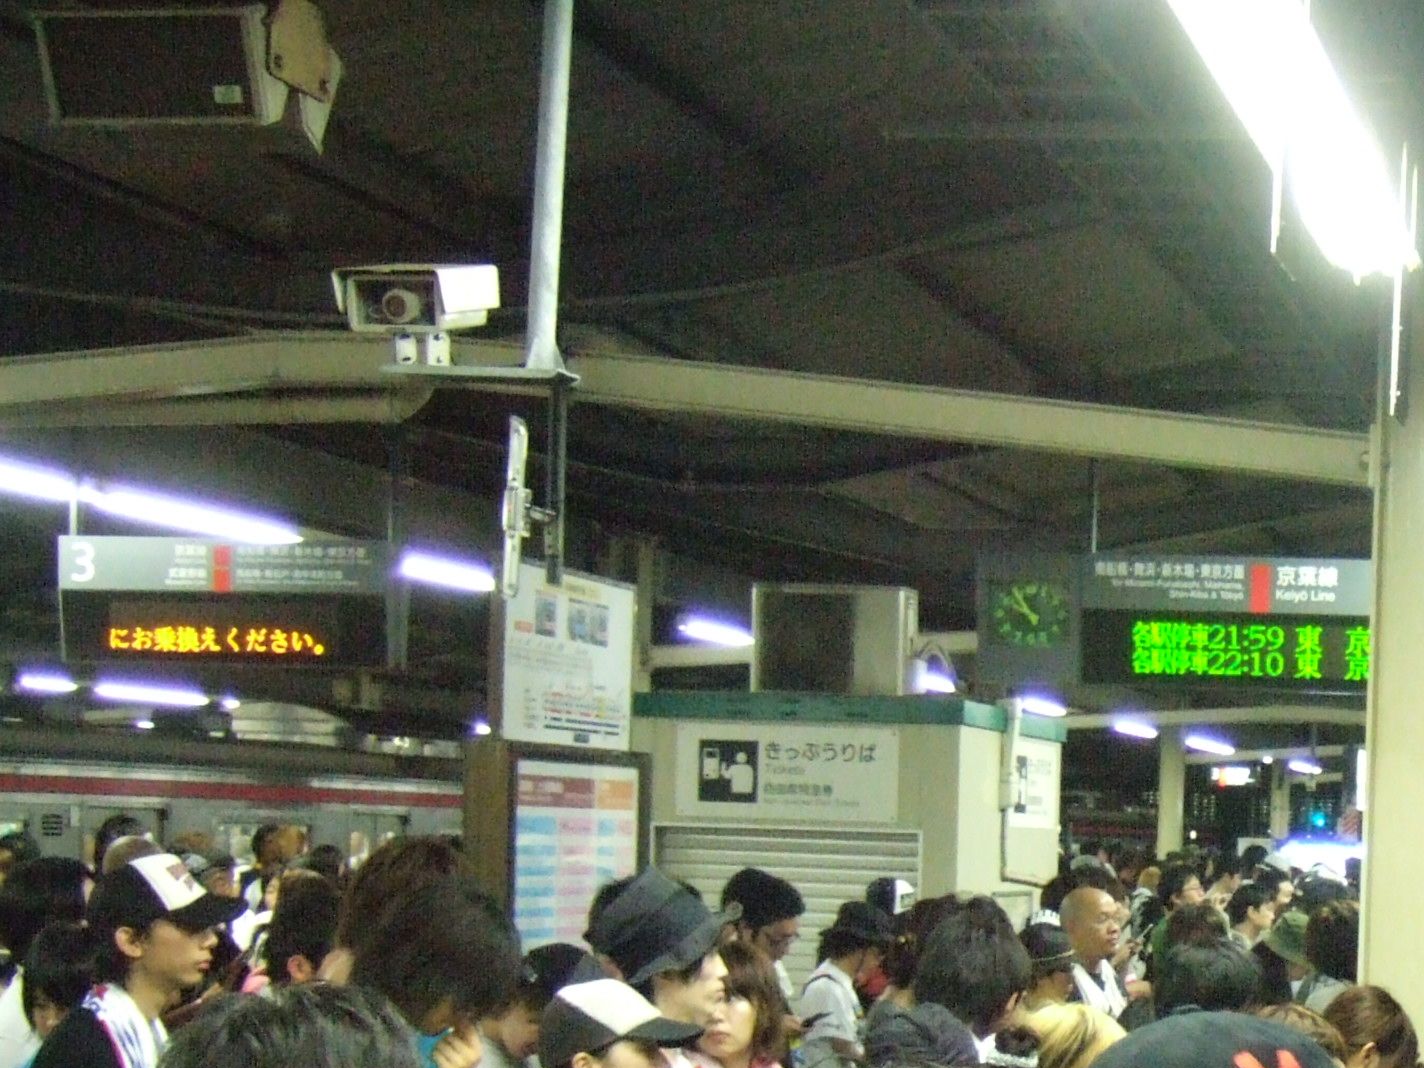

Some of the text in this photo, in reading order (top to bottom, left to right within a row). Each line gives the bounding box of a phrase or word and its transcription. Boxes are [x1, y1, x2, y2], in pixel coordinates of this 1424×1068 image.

[71, 542, 95, 582] 3
[764, 741, 877, 763] きっぷうりば
